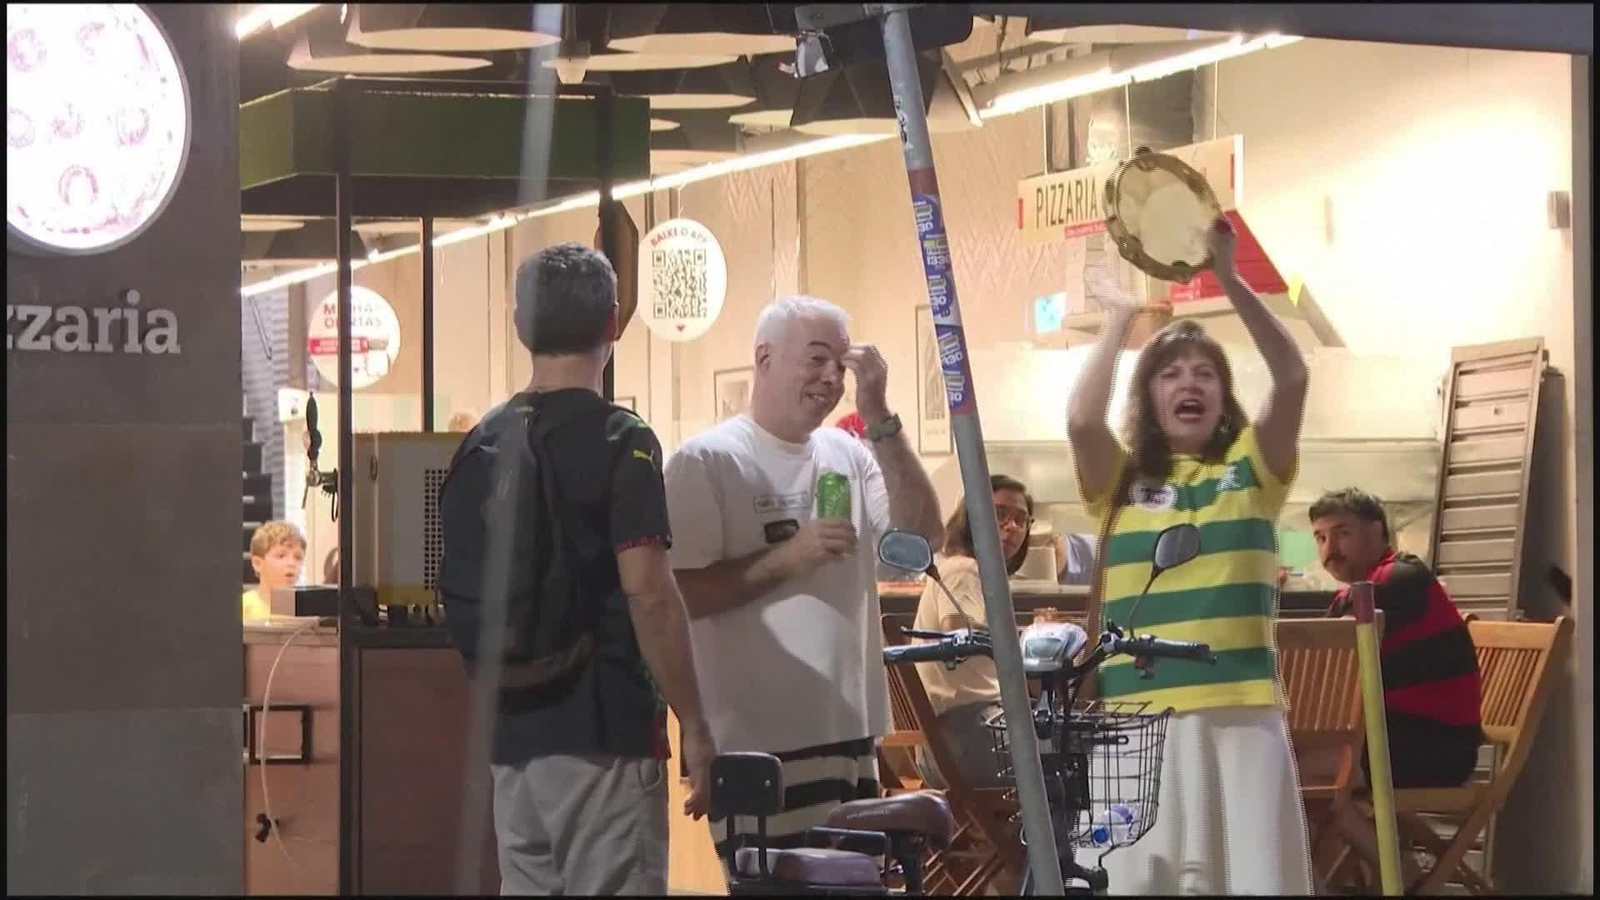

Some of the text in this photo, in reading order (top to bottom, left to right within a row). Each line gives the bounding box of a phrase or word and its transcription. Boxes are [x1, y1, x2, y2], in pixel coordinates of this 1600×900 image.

[1036, 176, 1098, 229] PIZZARIA
[651, 226, 678, 247] BAIXE
[7, 289, 181, 354] zaria
